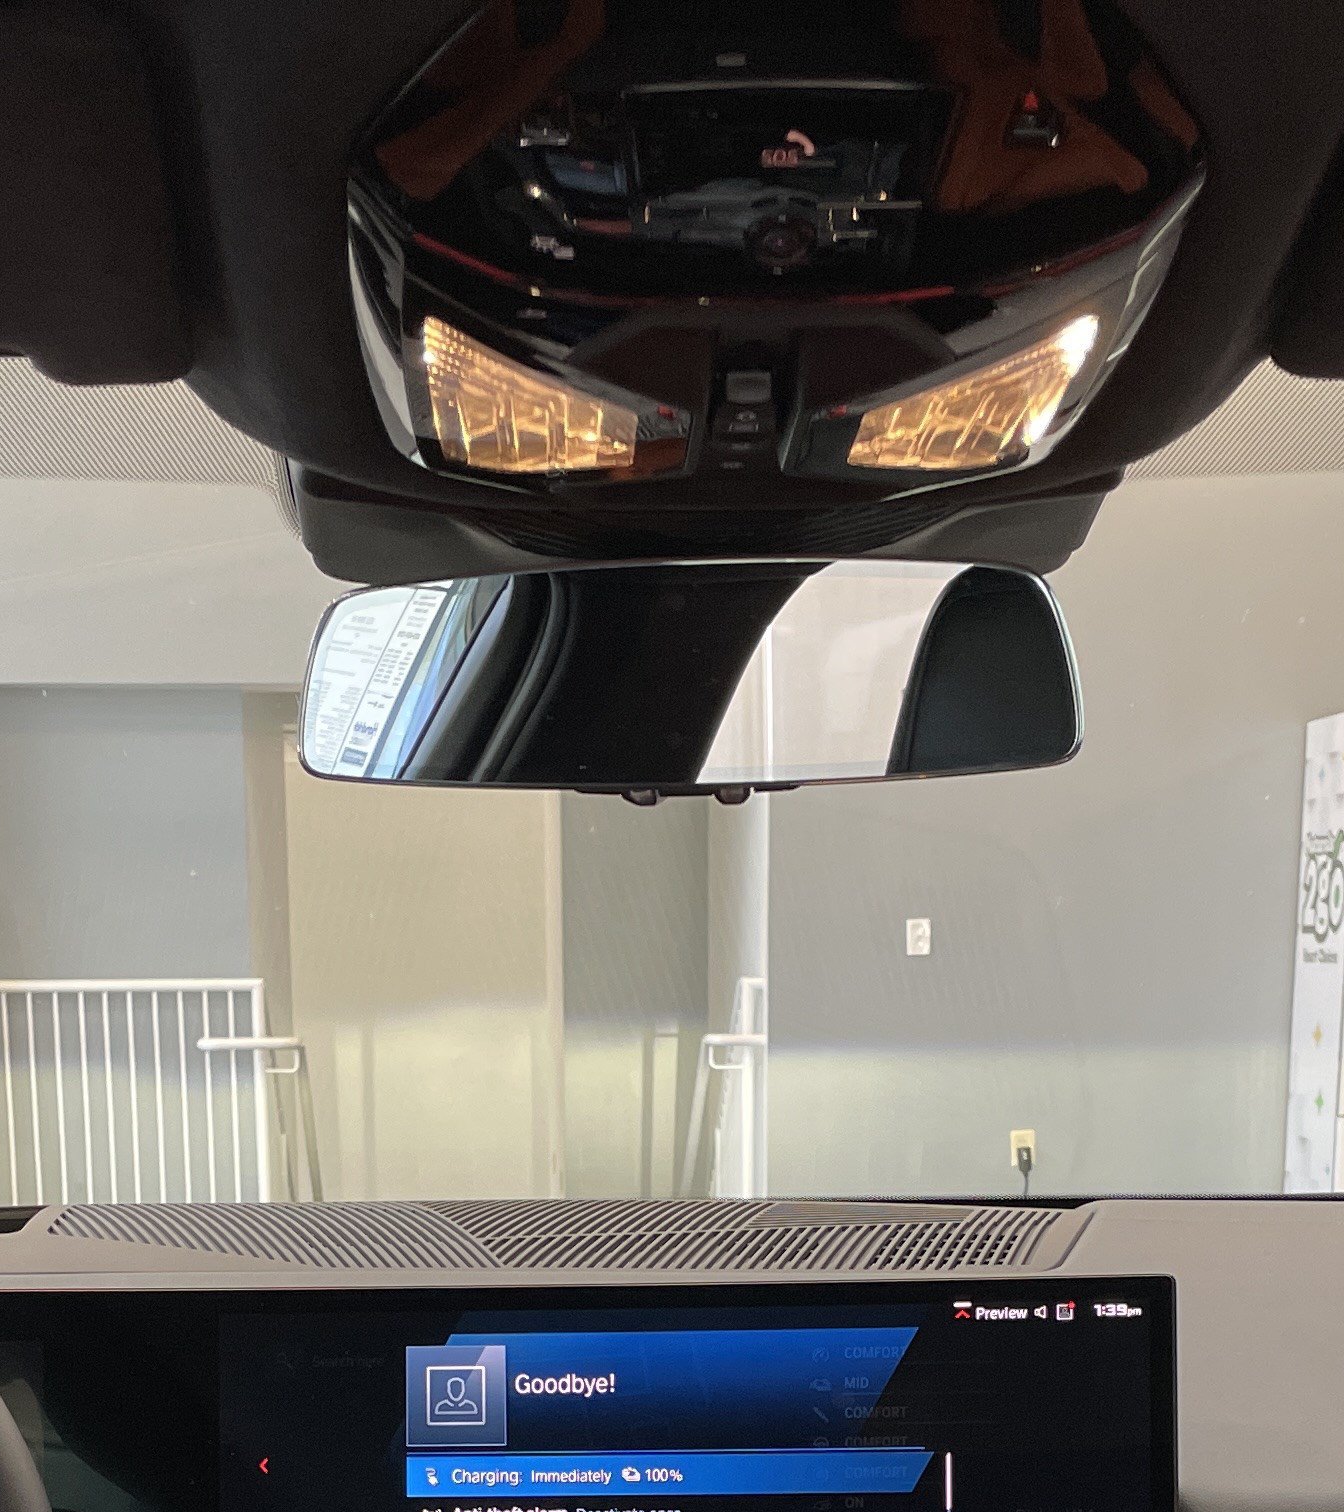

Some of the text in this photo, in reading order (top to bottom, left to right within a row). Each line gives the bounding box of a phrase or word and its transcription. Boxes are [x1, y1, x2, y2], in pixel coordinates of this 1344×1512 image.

[975, 1306, 1029, 1321] Preview
[514, 1373, 616, 1398] Goodbye!
[844, 1377, 870, 1390] MID
[451, 1468, 684, 1487] Charging: Immediately 100%
